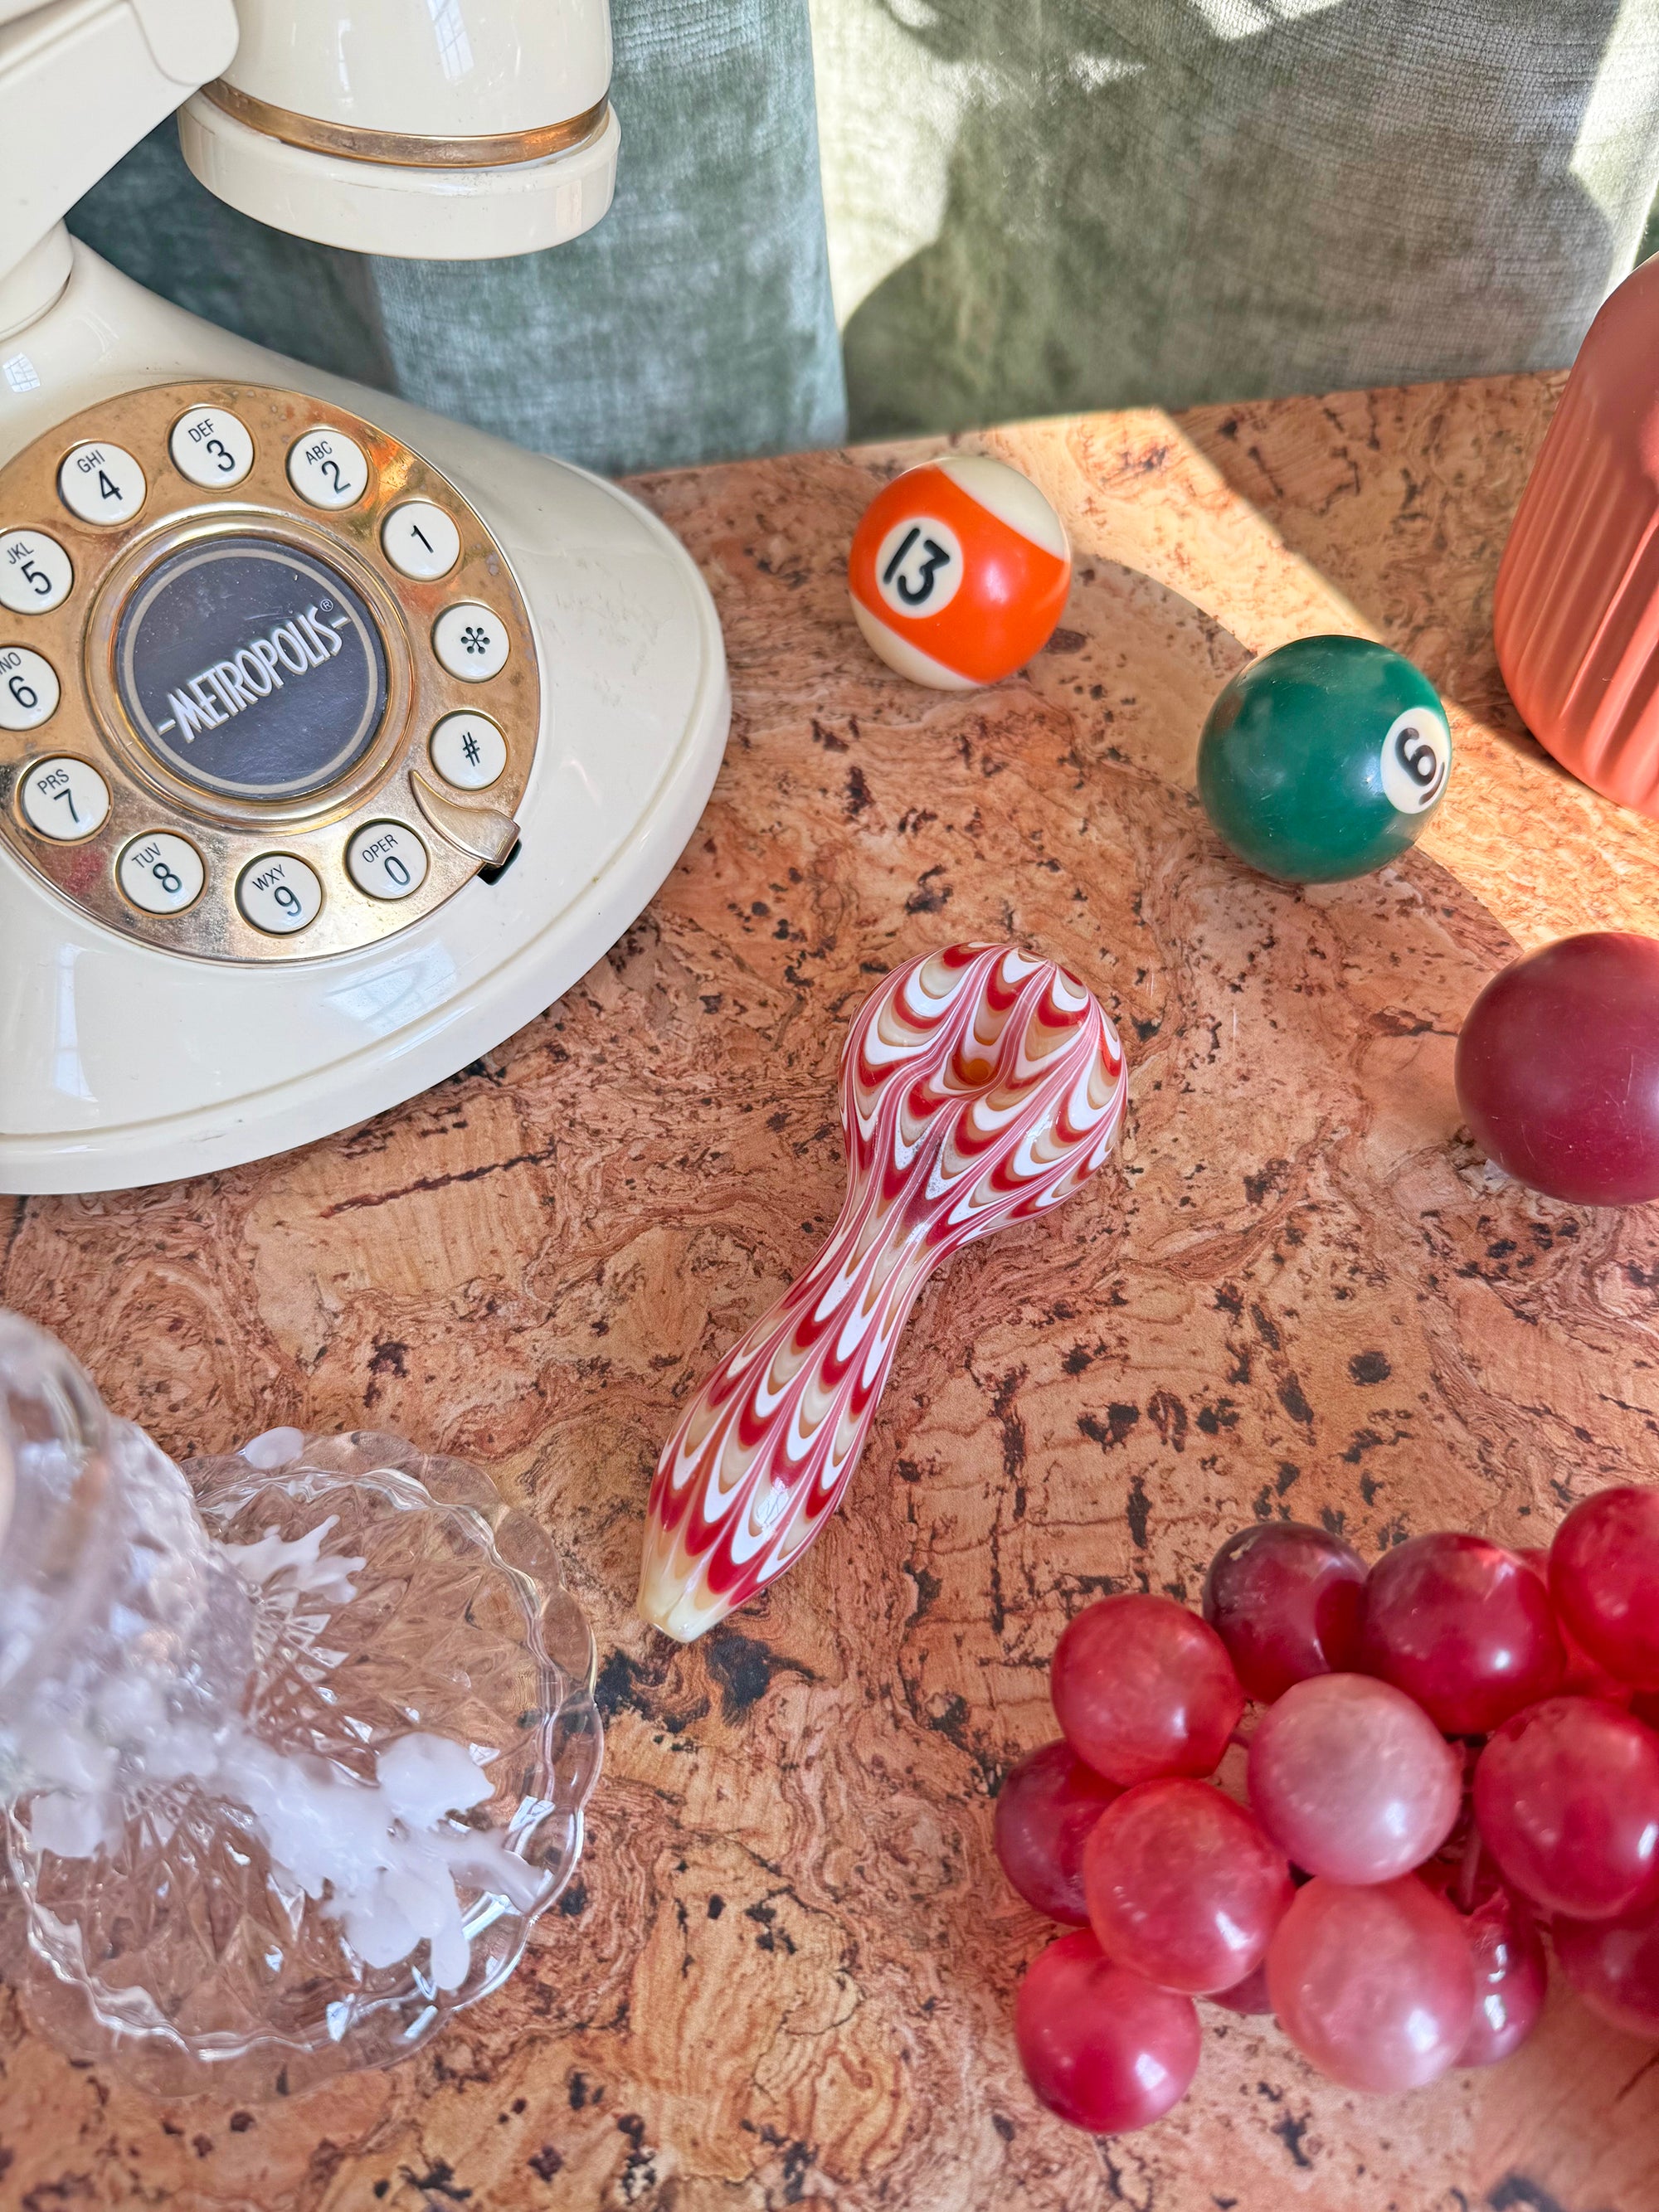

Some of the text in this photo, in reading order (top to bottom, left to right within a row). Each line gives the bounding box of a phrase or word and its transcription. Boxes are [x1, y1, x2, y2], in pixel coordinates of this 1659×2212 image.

[187, 418, 216, 443] DEF
[77, 450, 105, 473] GHI
[207, 440, 236, 472] 3
[304, 440, 333, 465] ABC
[99, 470, 124, 501] 4
[321, 460, 352, 494] 2
[8, 542, 34, 565] JKL
[411, 524, 434, 554] 1
[21, 560, 52, 596] 5
[883, 527, 951, 606] 13
[0, 652, 22, 674] NO
[8, 675, 38, 708] 6
[1394, 727, 1438, 787] 6
[36, 768, 70, 795] PRS
[53, 789, 80, 824] 7
[131, 842, 163, 869] TUV
[362, 834, 399, 863] OPER
[152, 862, 182, 894] 8
[252, 863, 285, 892] WXY
[384, 855, 411, 886] 0
[274, 885, 302, 916] 9
